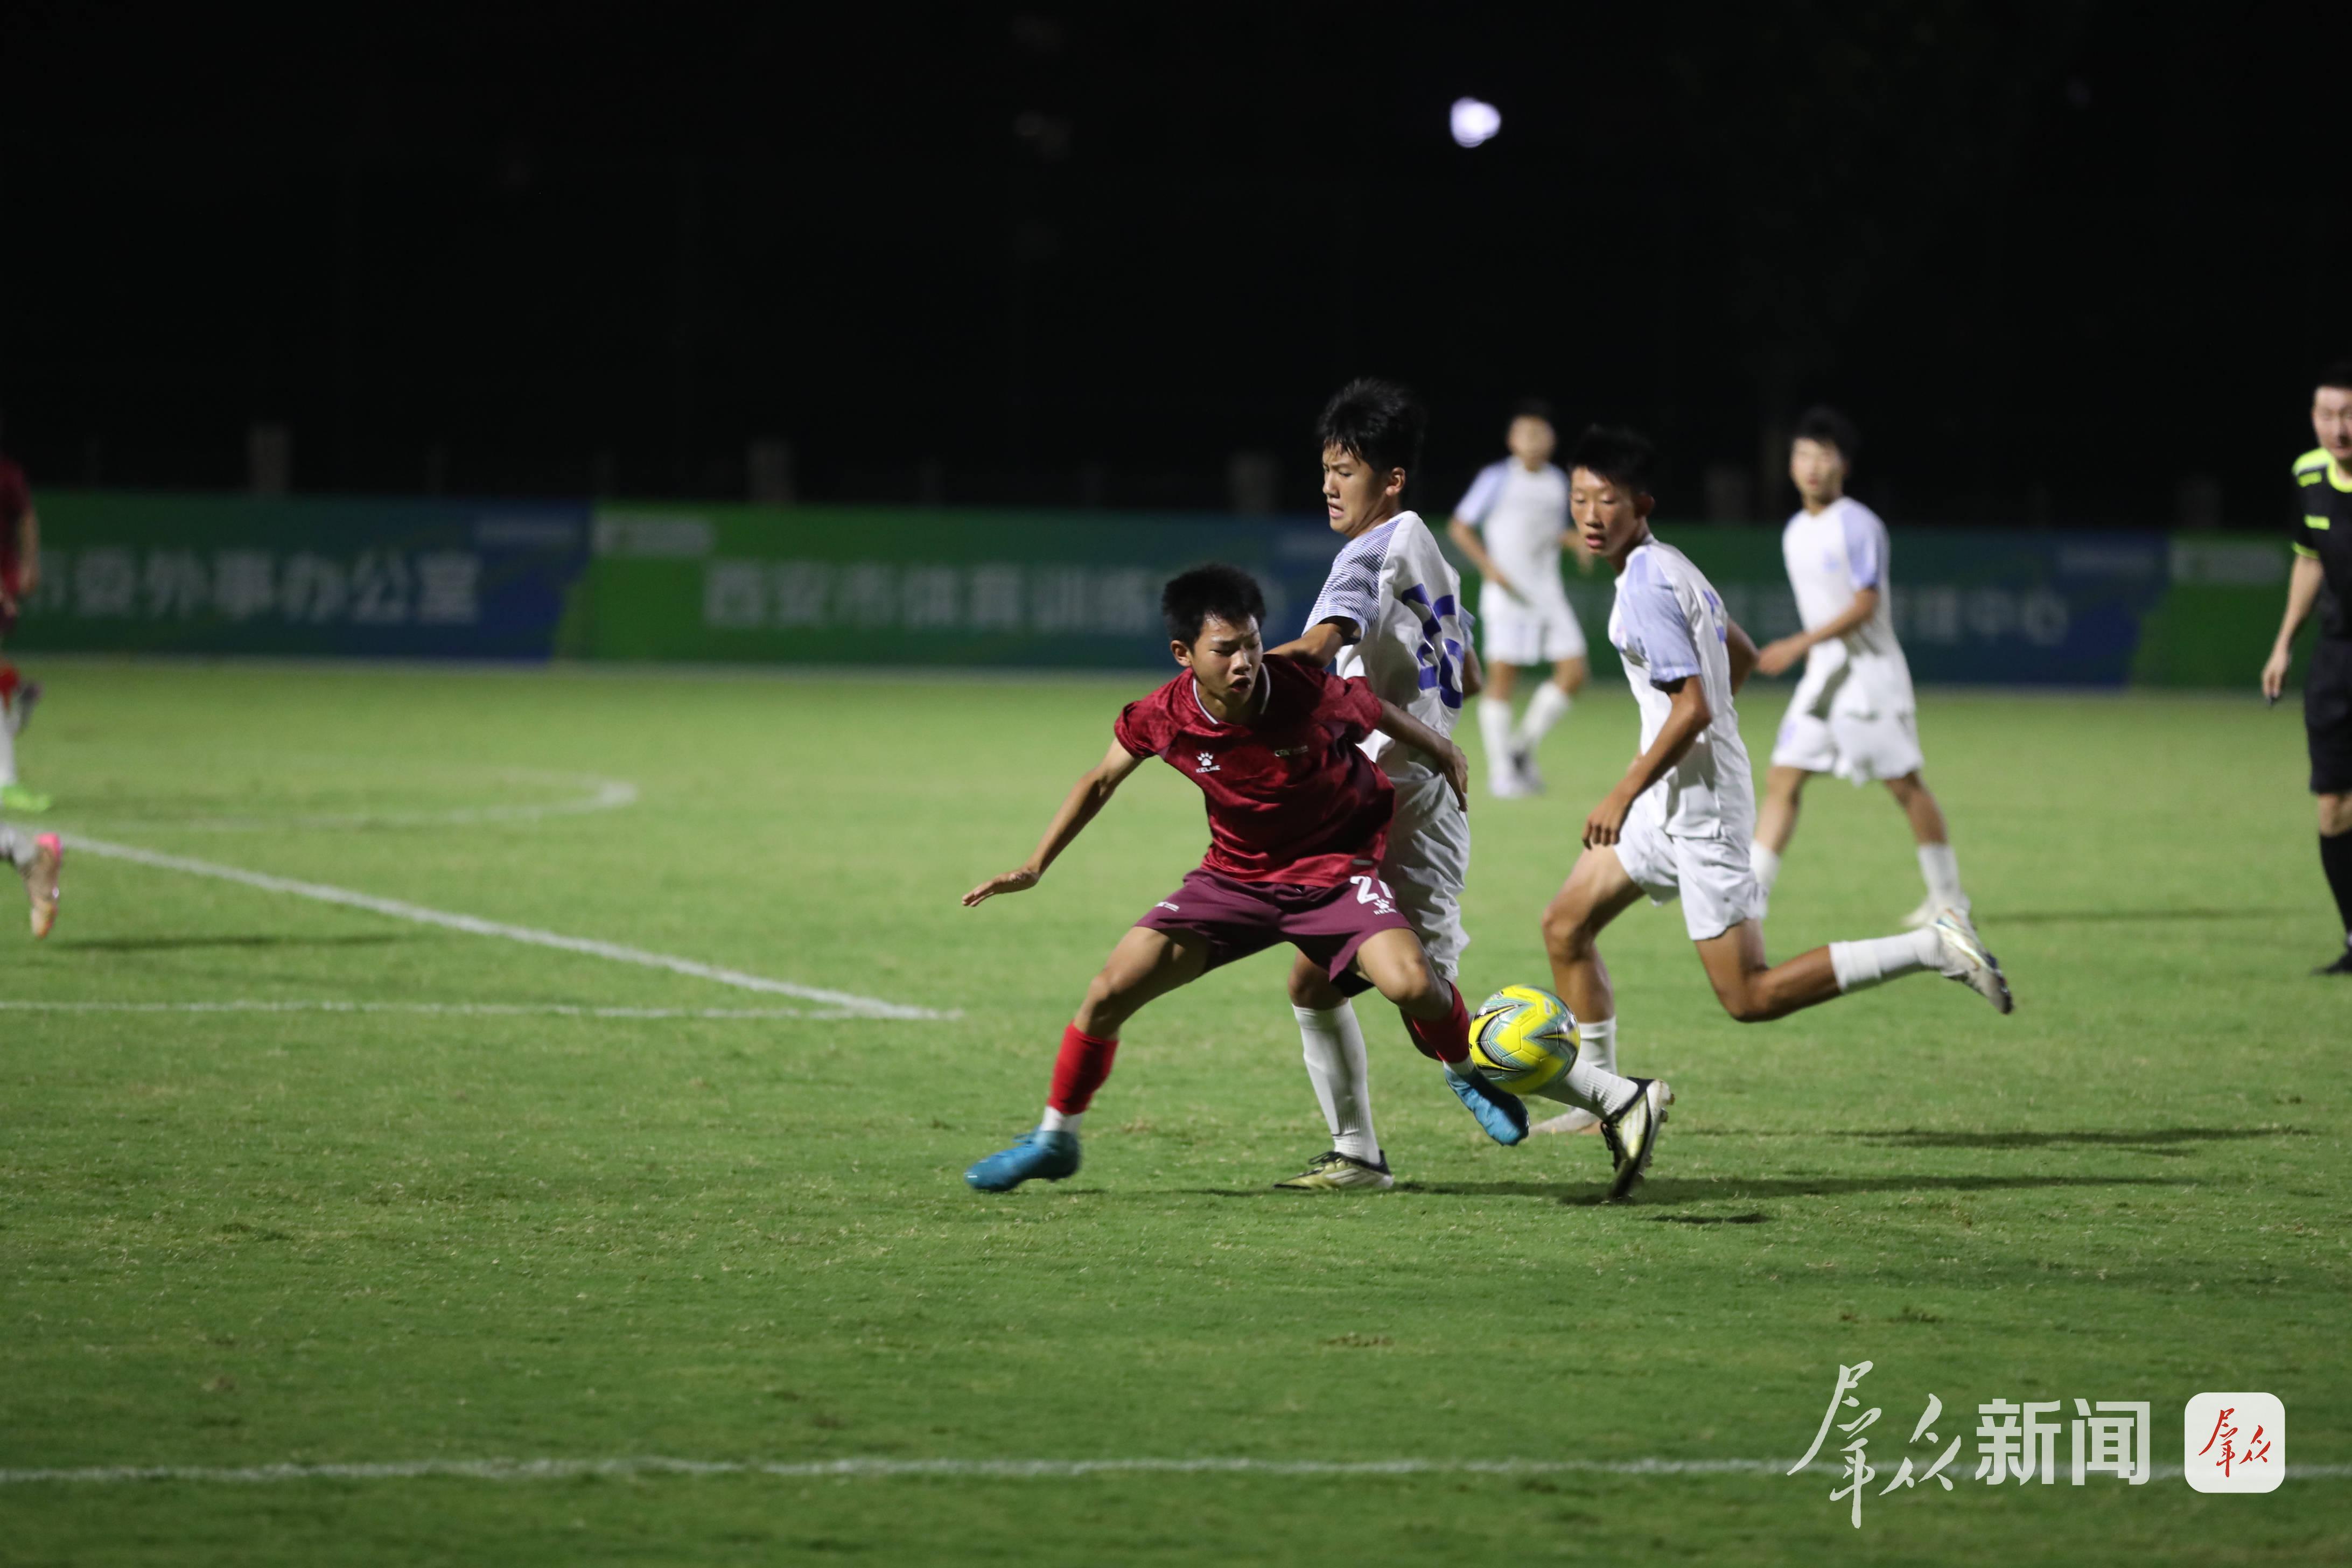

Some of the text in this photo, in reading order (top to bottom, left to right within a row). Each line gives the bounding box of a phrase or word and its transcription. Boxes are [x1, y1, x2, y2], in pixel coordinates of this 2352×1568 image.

[702, 561, 1286, 636] 西安市体育训练
